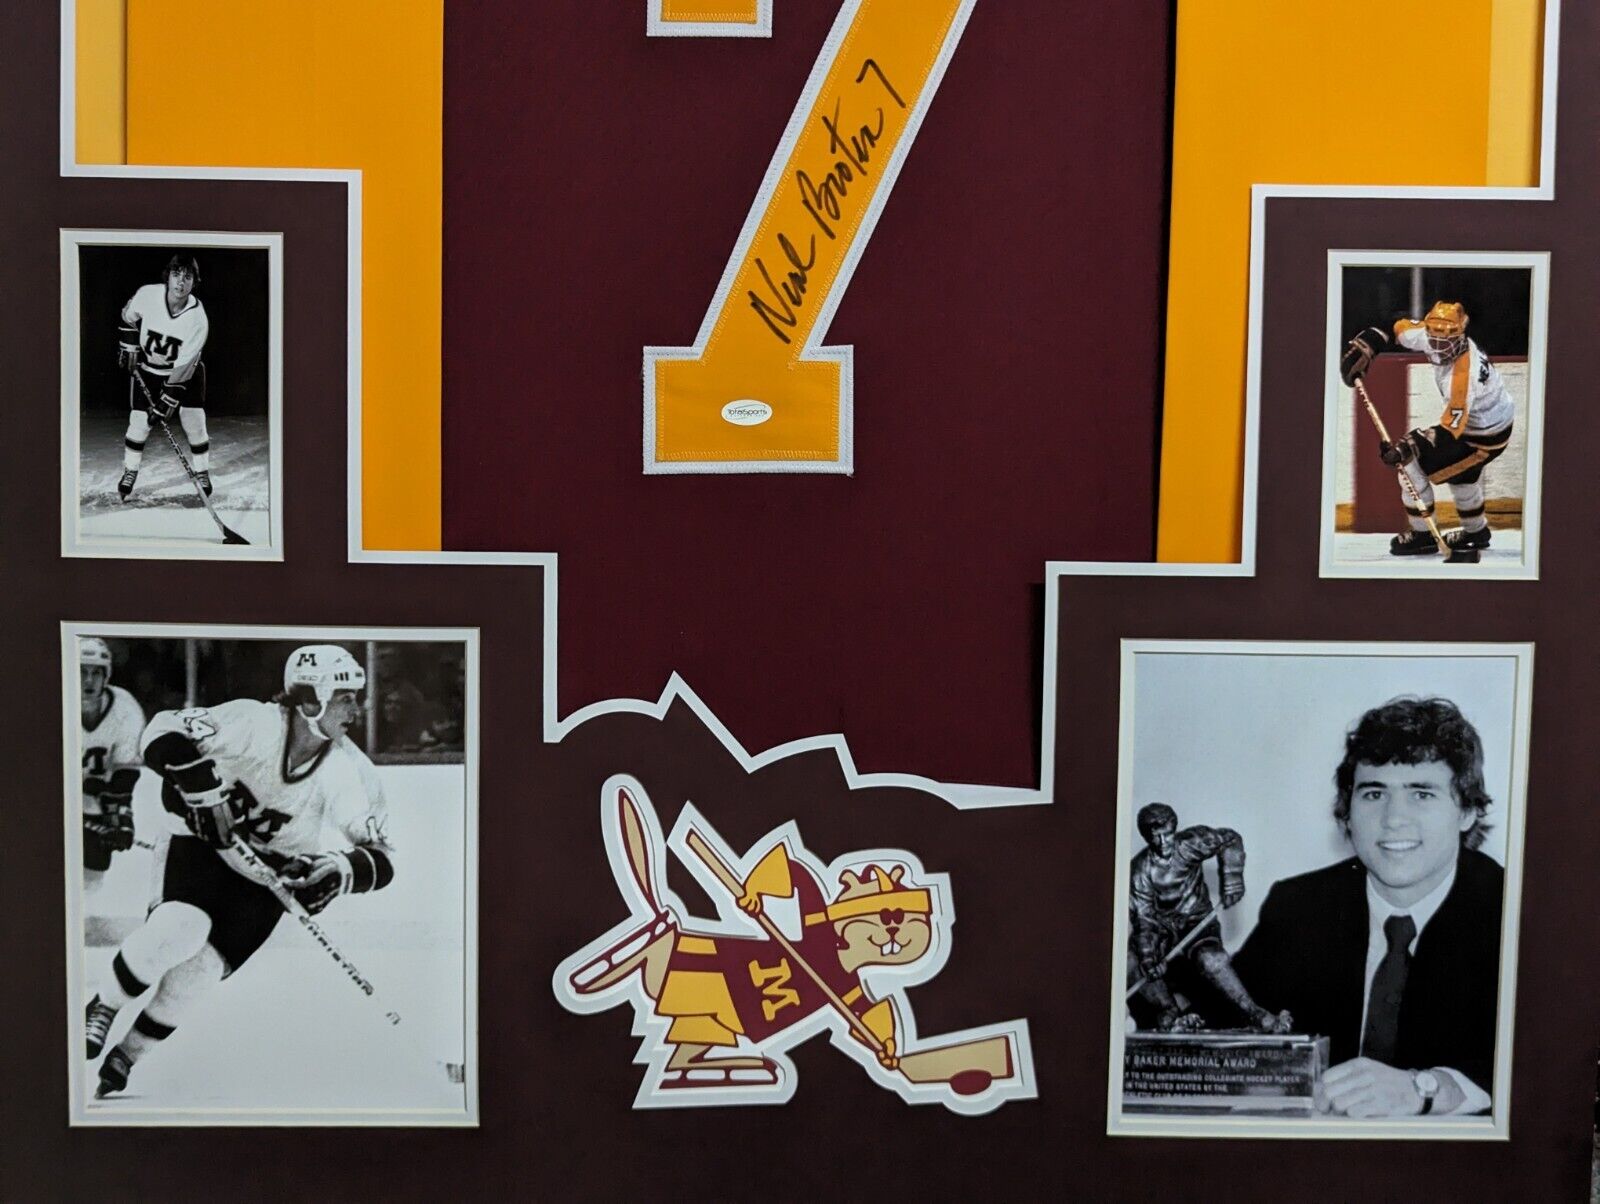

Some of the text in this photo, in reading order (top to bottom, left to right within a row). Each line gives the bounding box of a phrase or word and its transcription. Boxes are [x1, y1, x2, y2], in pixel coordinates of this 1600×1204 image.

[856, 59, 906, 108] 7
[143, 329, 183, 361] M
[1450, 408, 1464, 428] 7
[297, 653, 317, 667] M
[748, 958, 800, 1022] M
[1133, 1054, 1166, 1068] BAKER
[1169, 1055, 1220, 1068] MEMORIAL
[1223, 1057, 1257, 1069] AWARD
[1204, 1074, 1244, 1082] COLLEGIATE
[1246, 1075, 1273, 1083] HOCKEY
[1175, 1083, 1202, 1092] STATES
